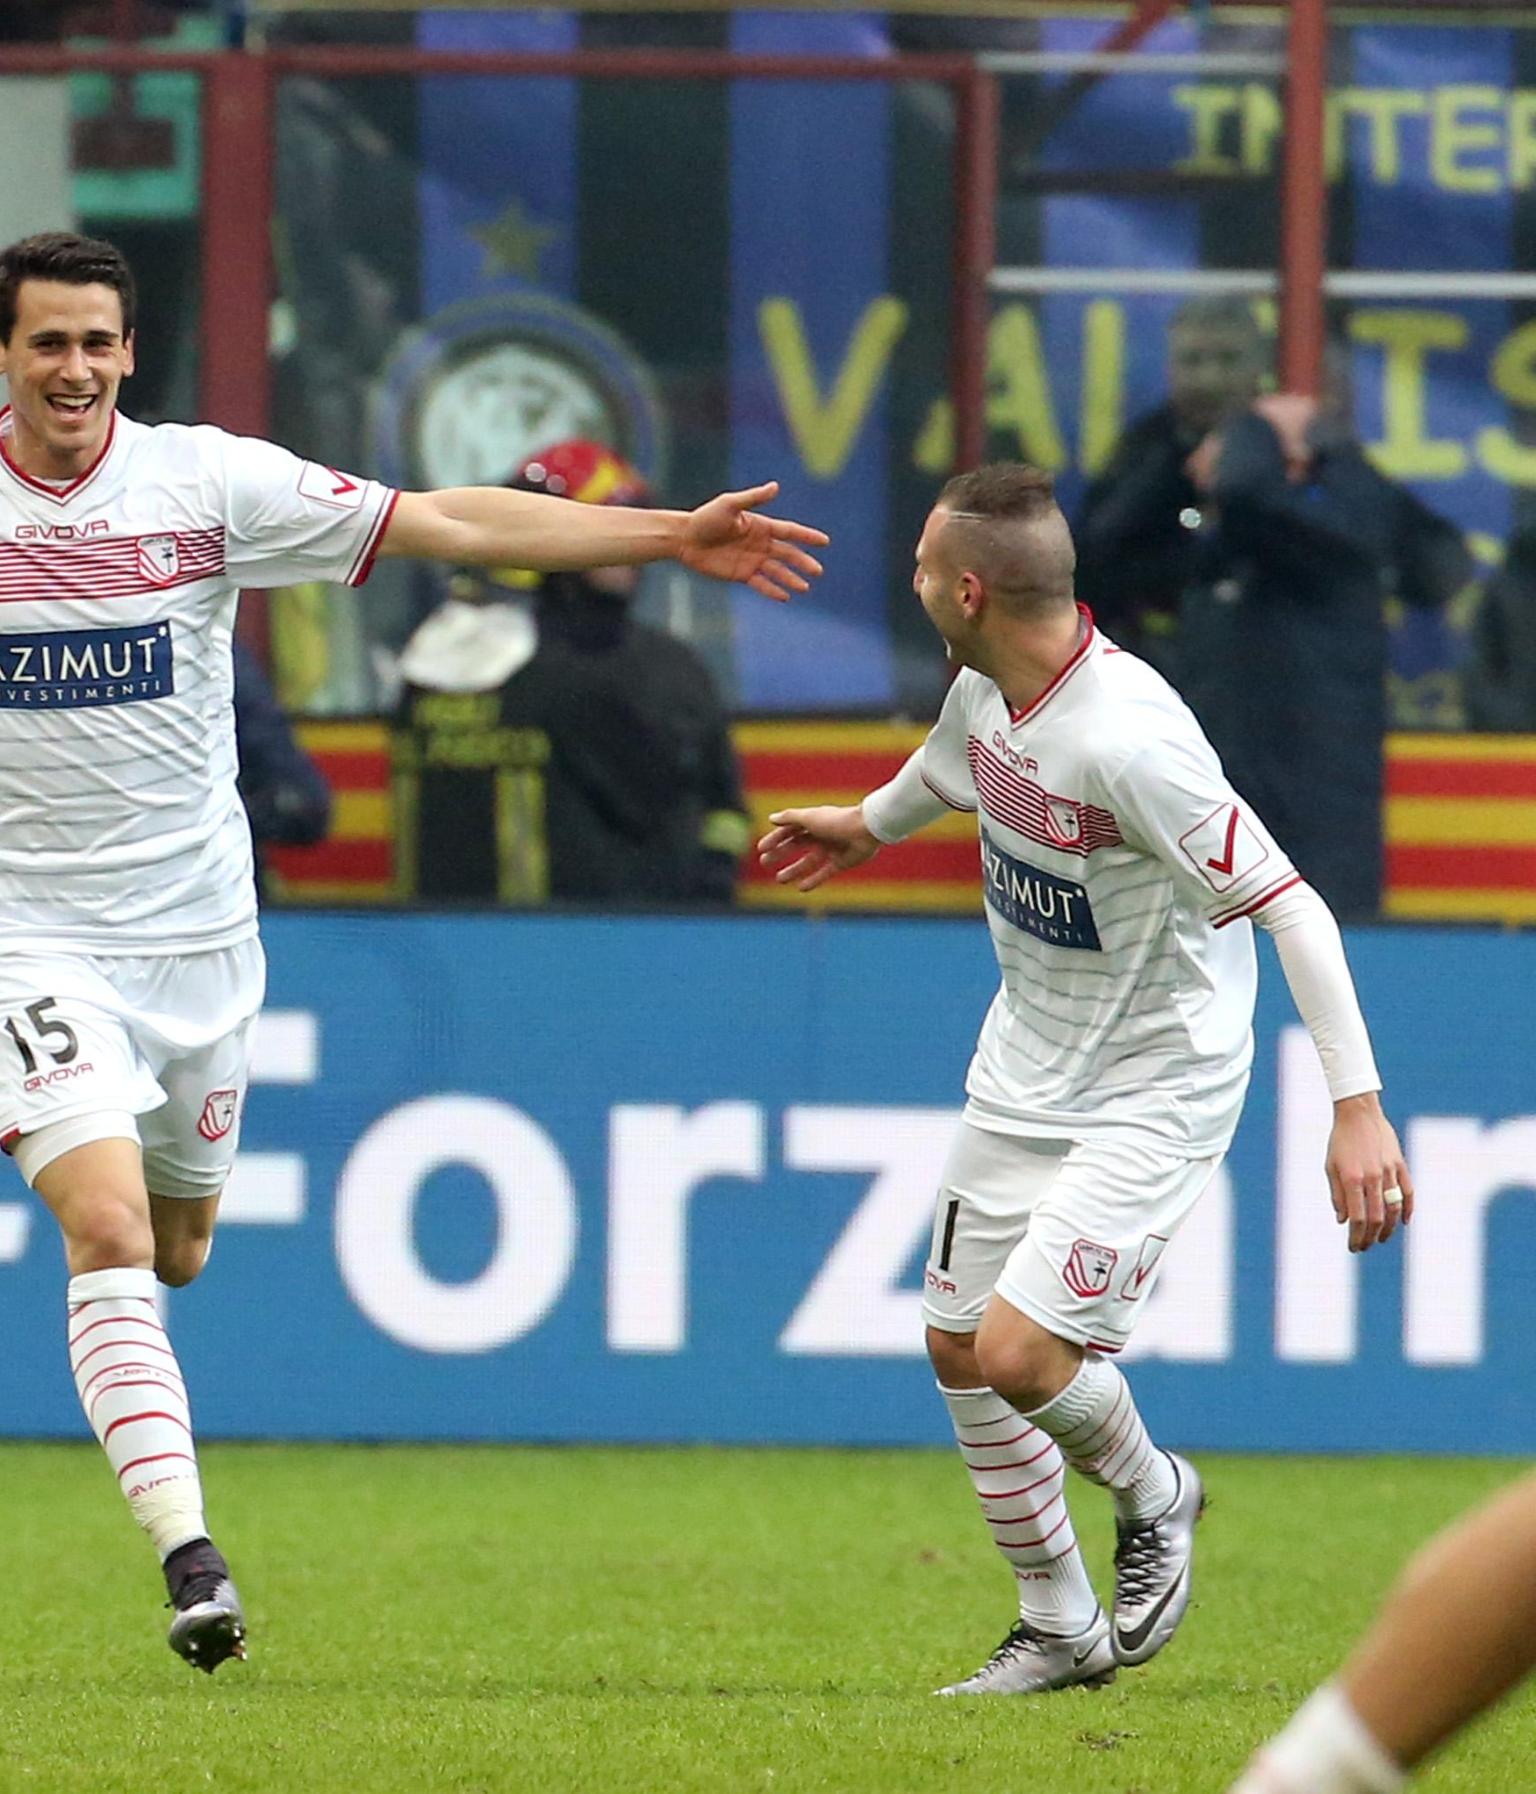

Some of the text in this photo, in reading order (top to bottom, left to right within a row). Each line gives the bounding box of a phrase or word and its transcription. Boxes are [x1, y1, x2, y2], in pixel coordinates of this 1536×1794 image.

[15, 519, 109, 540] GIVOVA
[4, 996, 79, 1075] 15
[23, 1062, 95, 1093] GIVOVA
